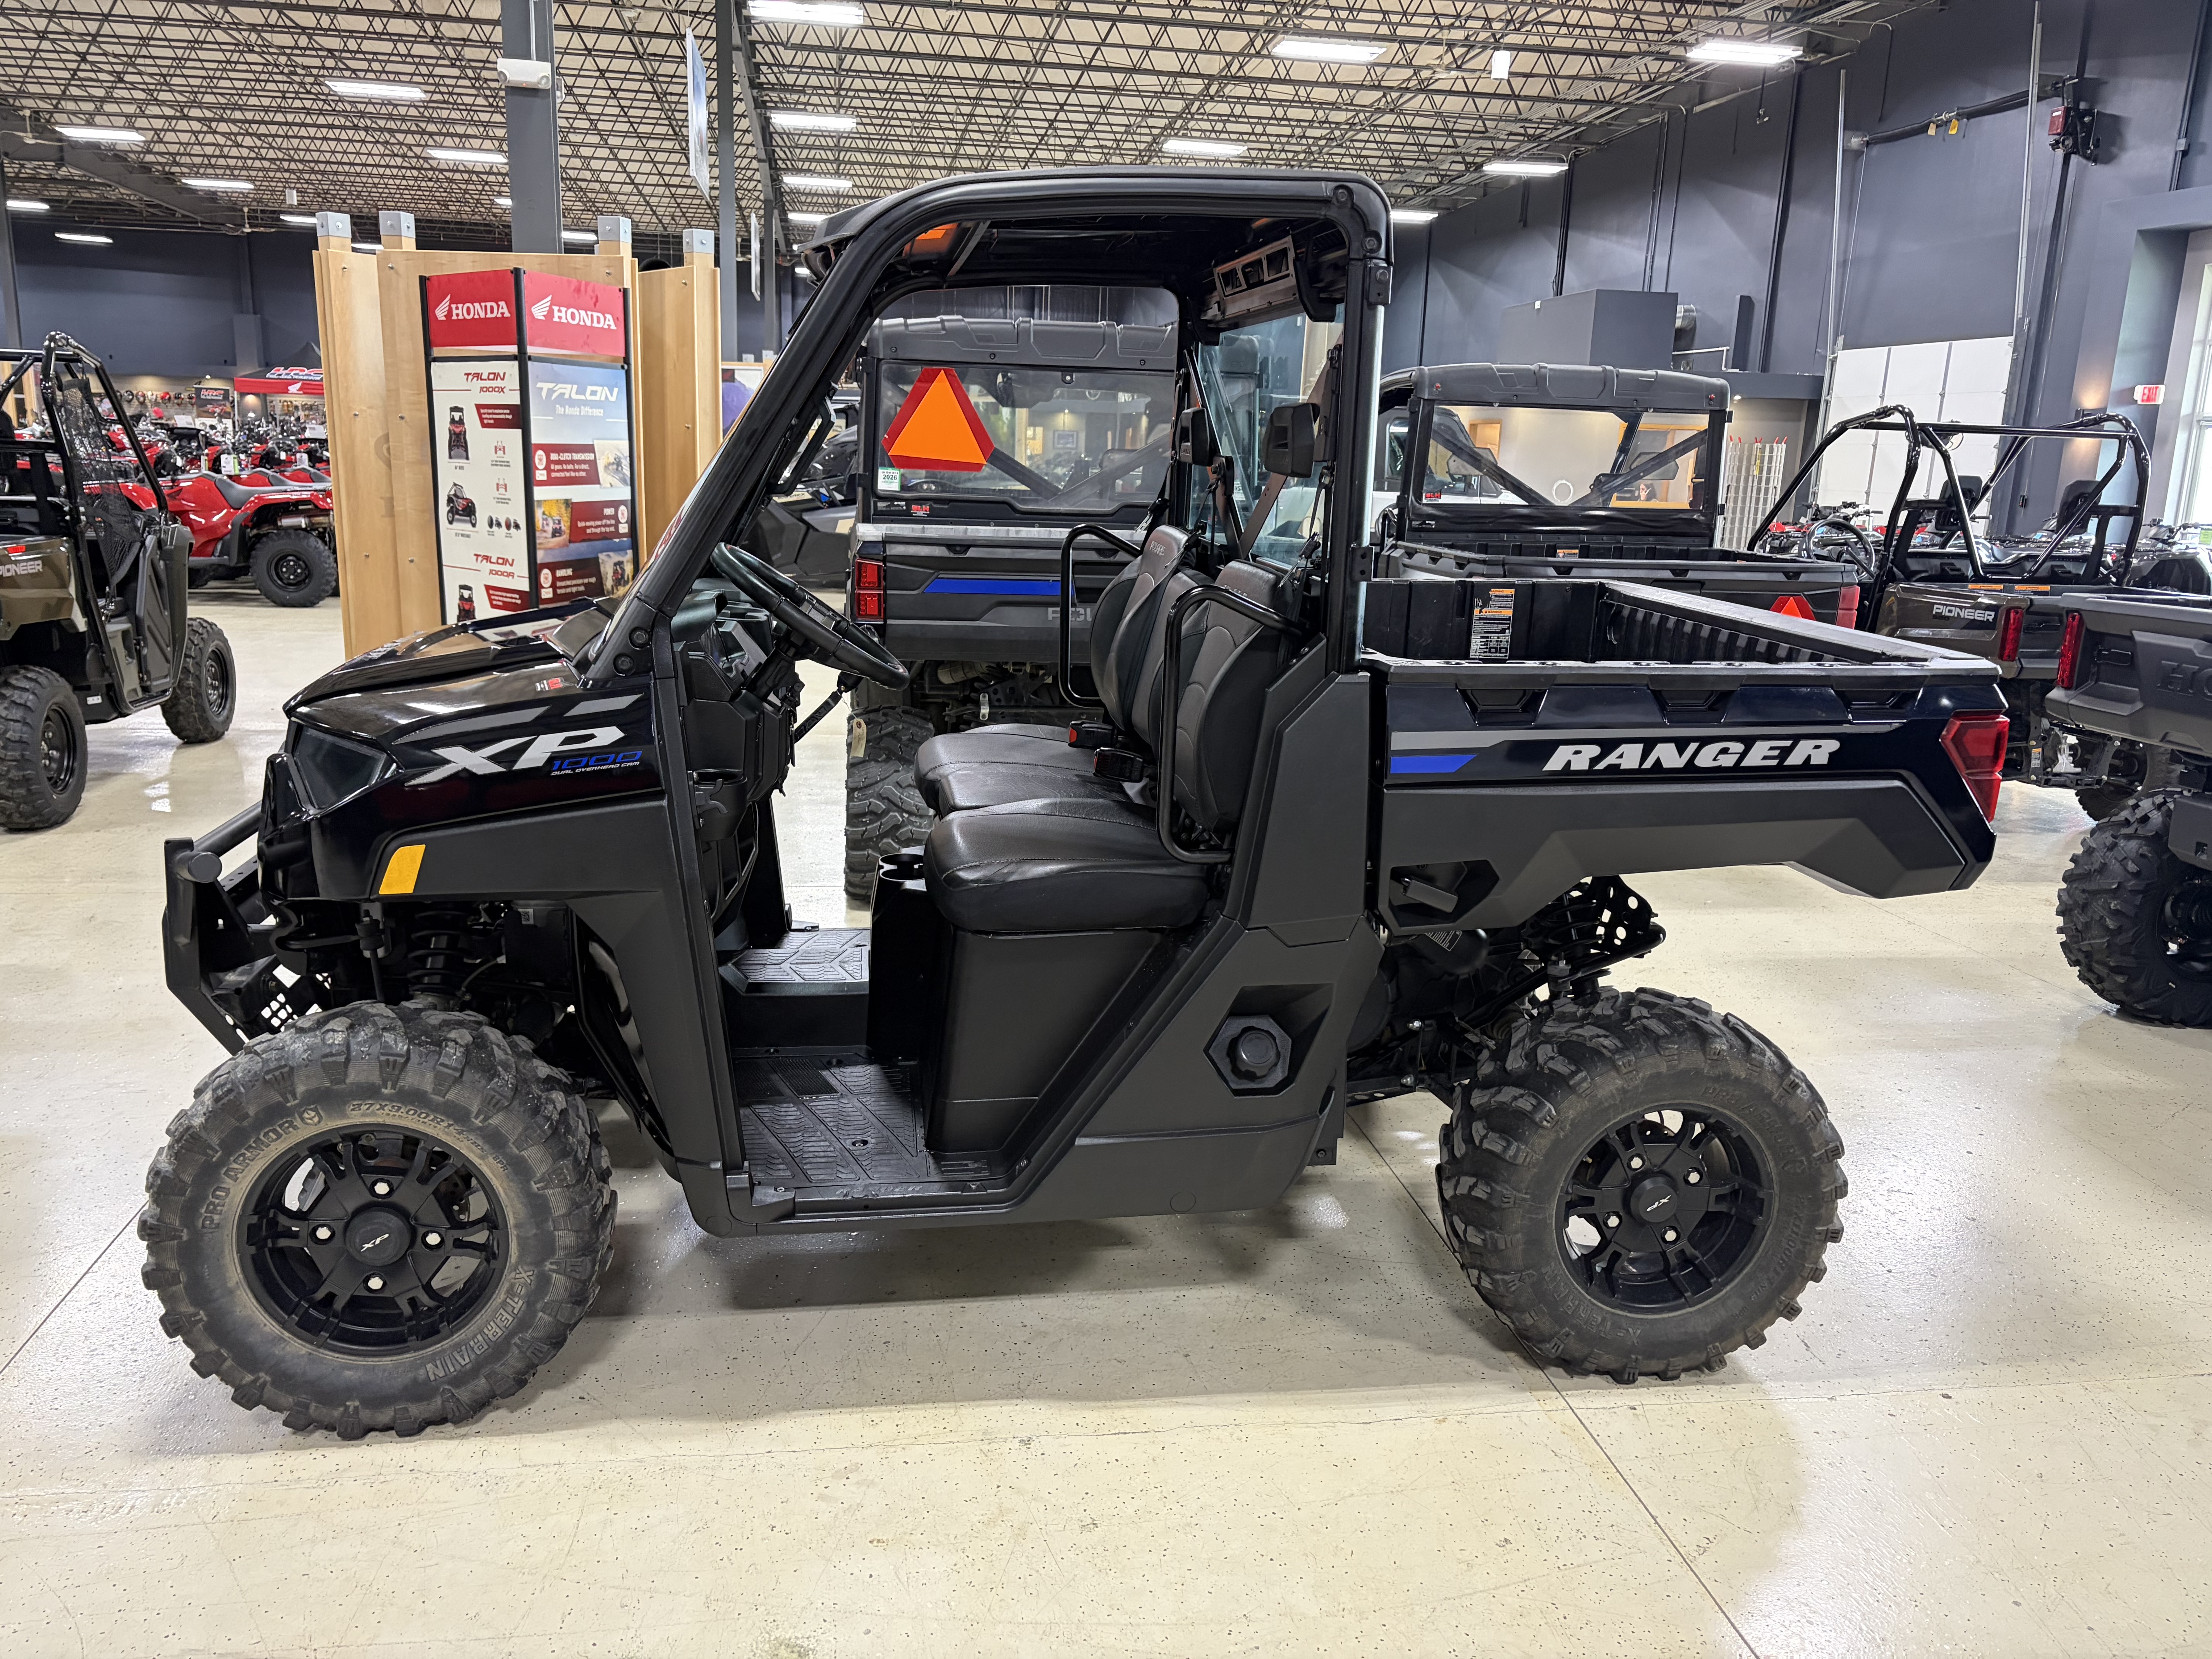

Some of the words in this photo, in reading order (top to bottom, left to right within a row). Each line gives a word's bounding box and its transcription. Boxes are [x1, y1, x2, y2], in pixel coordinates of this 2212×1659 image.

[451, 301, 510, 319] HONDA
[552, 305, 617, 330] HONDA
[464, 372, 506, 383] TALON
[536, 382, 618, 402] TALON
[2141, 386, 2159, 402] EXIT
[556, 405, 564, 414] The
[565, 405, 580, 415] Honda
[581, 406, 603, 416] Difference
[474, 553, 515, 567] TALON
[489, 569, 515, 579] 1000R
[1933, 605, 1995, 622] PIONEER
[405, 726, 626, 786] XP
[553, 750, 642, 771] 1000
[1542, 739, 1840, 771] RANGER
[575, 763, 618, 773] OVERHEAD
[492, 1154, 509, 1172] 8PR
[201, 1185, 230, 1229] PRO
[222, 1119, 300, 1182] ARMOR
[1647, 1195, 1671, 1211] XP
[361, 1234, 389, 1252] XP
[1541, 1262, 1642, 1346] X-TERRAIN
[426, 1266, 535, 1382] X-TERRAIN
